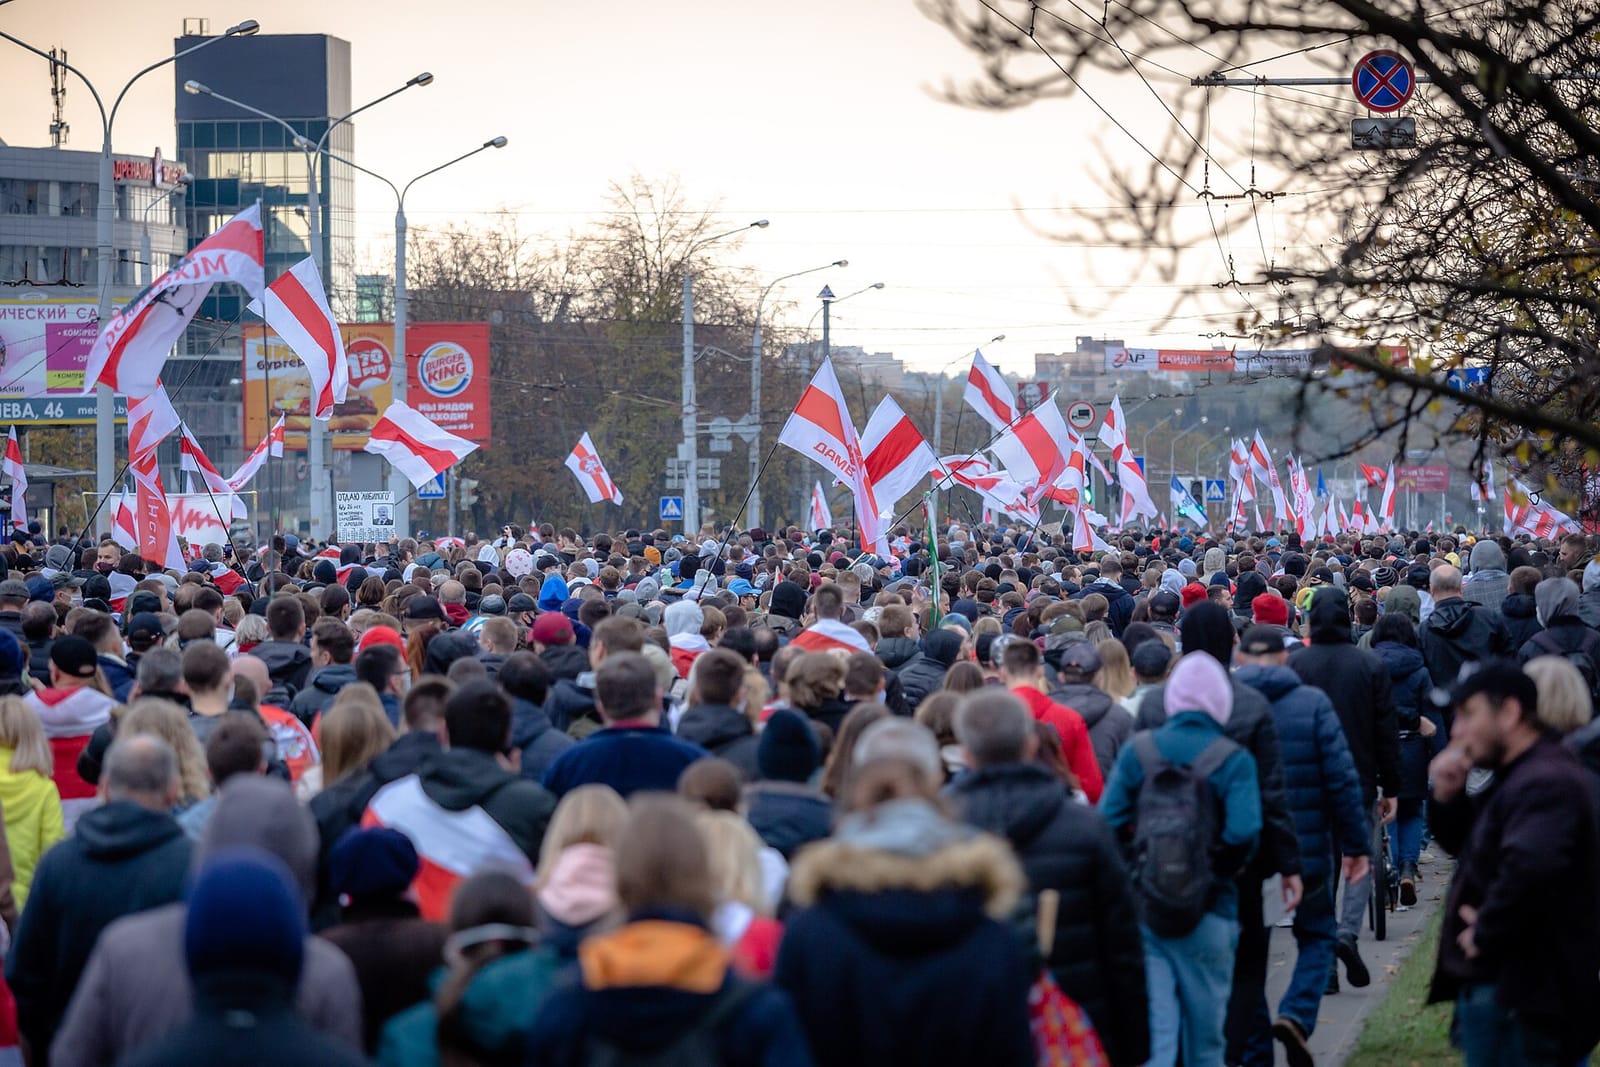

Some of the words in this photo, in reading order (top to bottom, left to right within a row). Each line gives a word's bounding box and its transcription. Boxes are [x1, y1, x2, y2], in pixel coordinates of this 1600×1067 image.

[256, 358, 305, 370] бургер
[426, 352, 465, 373] BURGER
[427, 361, 467, 385] KING
[44, 402, 64, 418] 46
